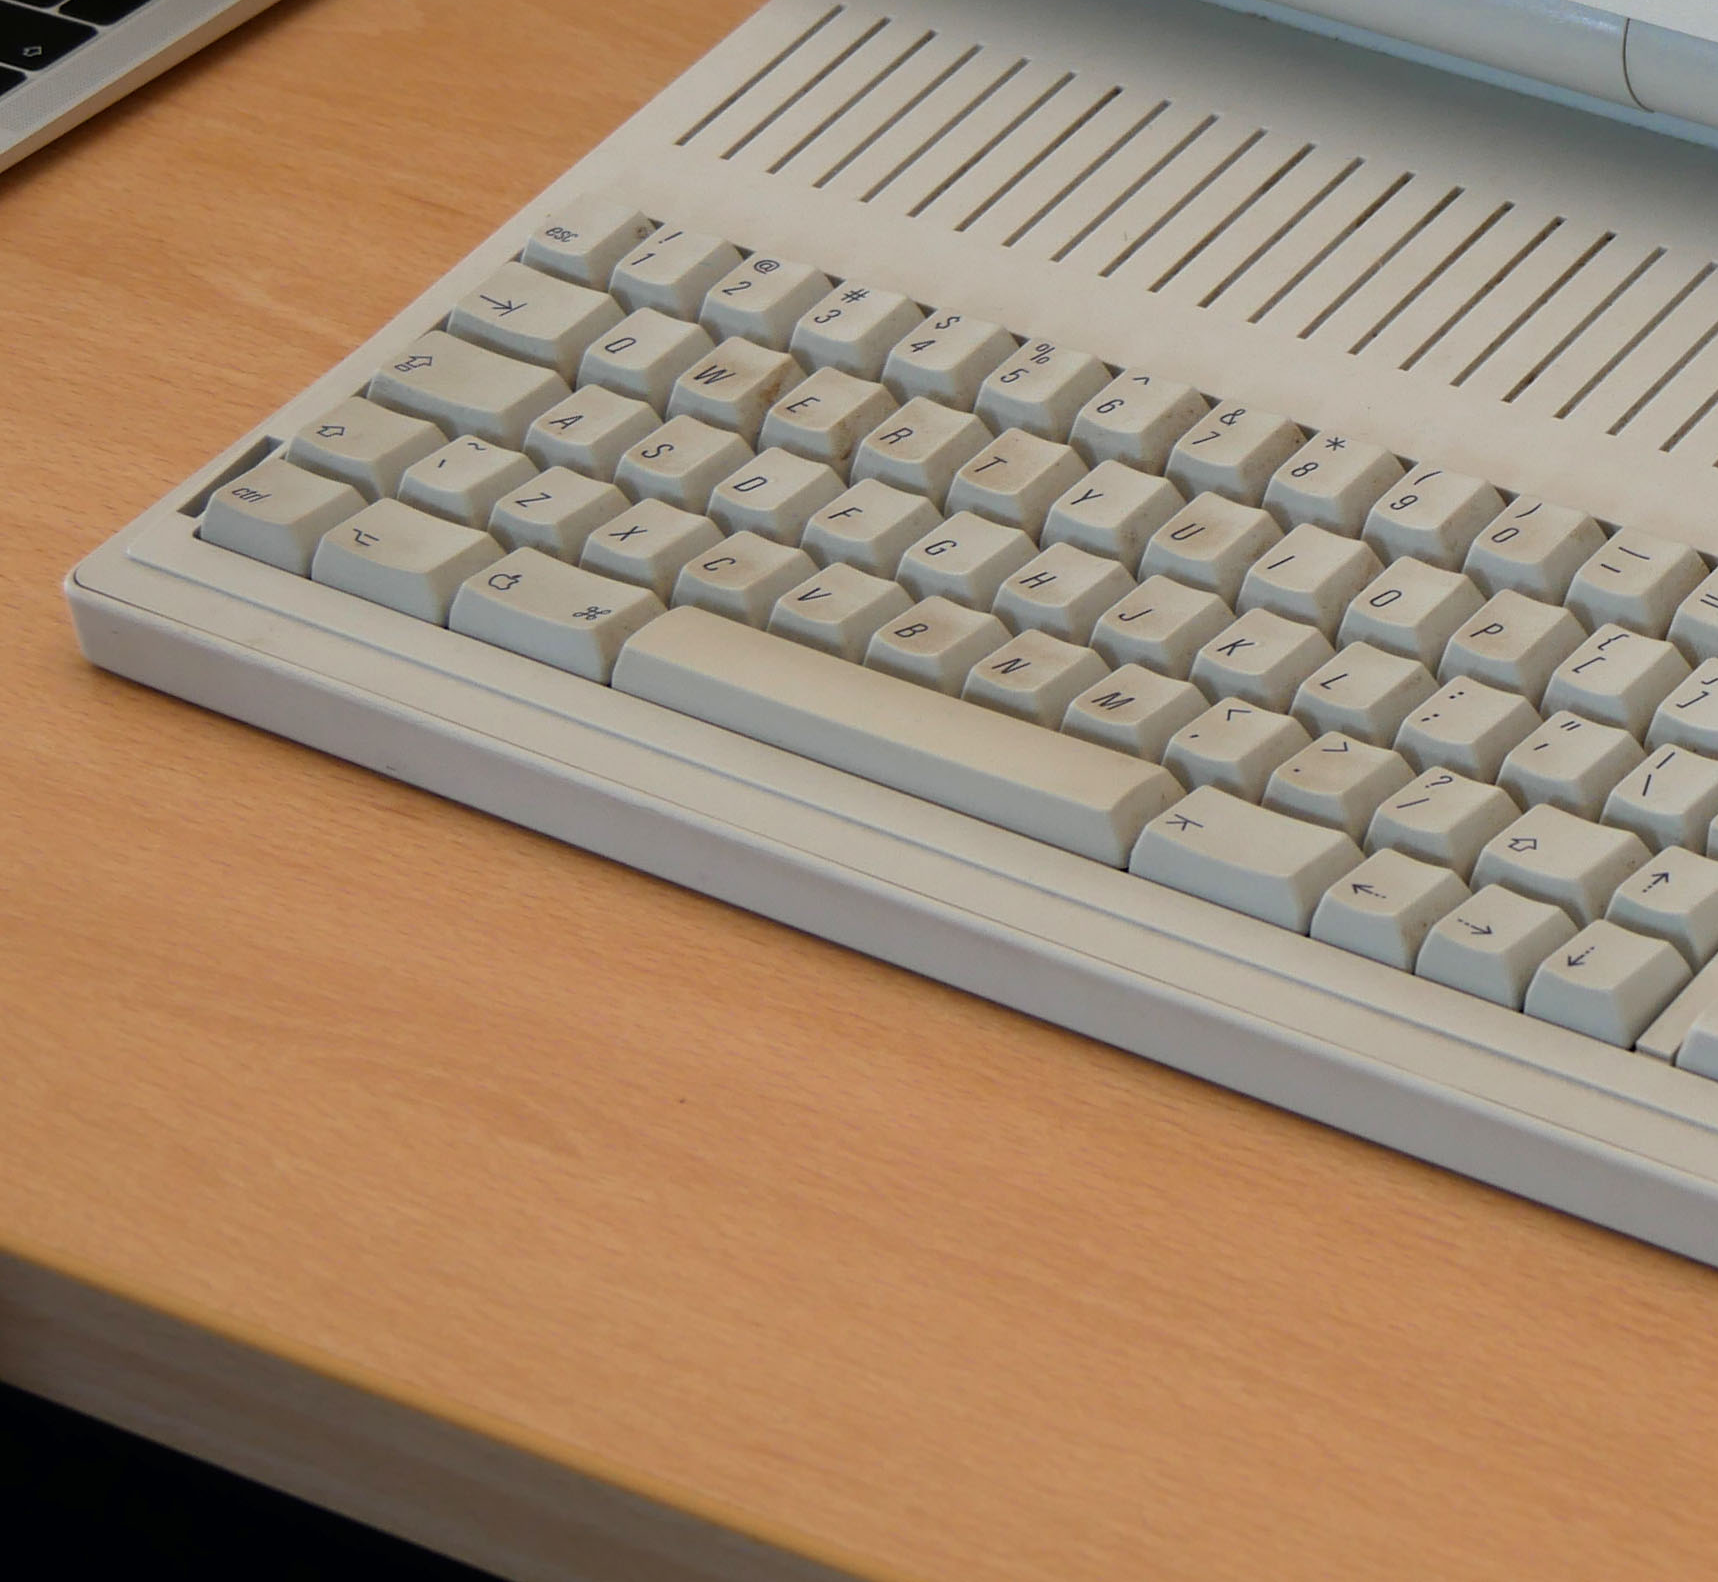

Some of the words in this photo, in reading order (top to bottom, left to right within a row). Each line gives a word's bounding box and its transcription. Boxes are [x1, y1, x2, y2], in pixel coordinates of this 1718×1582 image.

[631, 253, 656, 266] 1
[722, 280, 752, 296] 2
[814, 309, 842, 325] 3
[910, 339, 936, 353] 4
[693, 364, 736, 386] W
[1000, 368, 1030, 384] 5
[786, 396, 821, 414] E
[1096, 398, 1125, 414] 6
[549, 414, 584, 430] A
[879, 426, 914, 445] R
[1192, 431, 1221, 445] 7
[641, 443, 674, 459] S
[974, 456, 1007, 473] T
[1291, 461, 1319, 478] 8
[733, 476, 768, 493] D
[231, 486, 272, 503] ctrl
[515, 492, 552, 508] Z
[1070, 488, 1103, 506] Y
[1390, 494, 1418, 511] 9
[827, 506, 863, 520] F
[609, 525, 648, 541] X
[1170, 522, 1206, 541] U
[924, 539, 957, 557] G
[703, 557, 736, 572] C
[1267, 555, 1295, 570] I
[1019, 571, 1057, 589] H
[797, 587, 832, 603] V
[1369, 589, 1403, 608] O
[1118, 608, 1153, 623] J
[894, 623, 929, 639] B
[1469, 622, 1504, 638] P
[1216, 638, 1256, 656] K
[992, 657, 1032, 675] N
[1320, 673, 1348, 690] L
[1091, 691, 1135, 711] M
